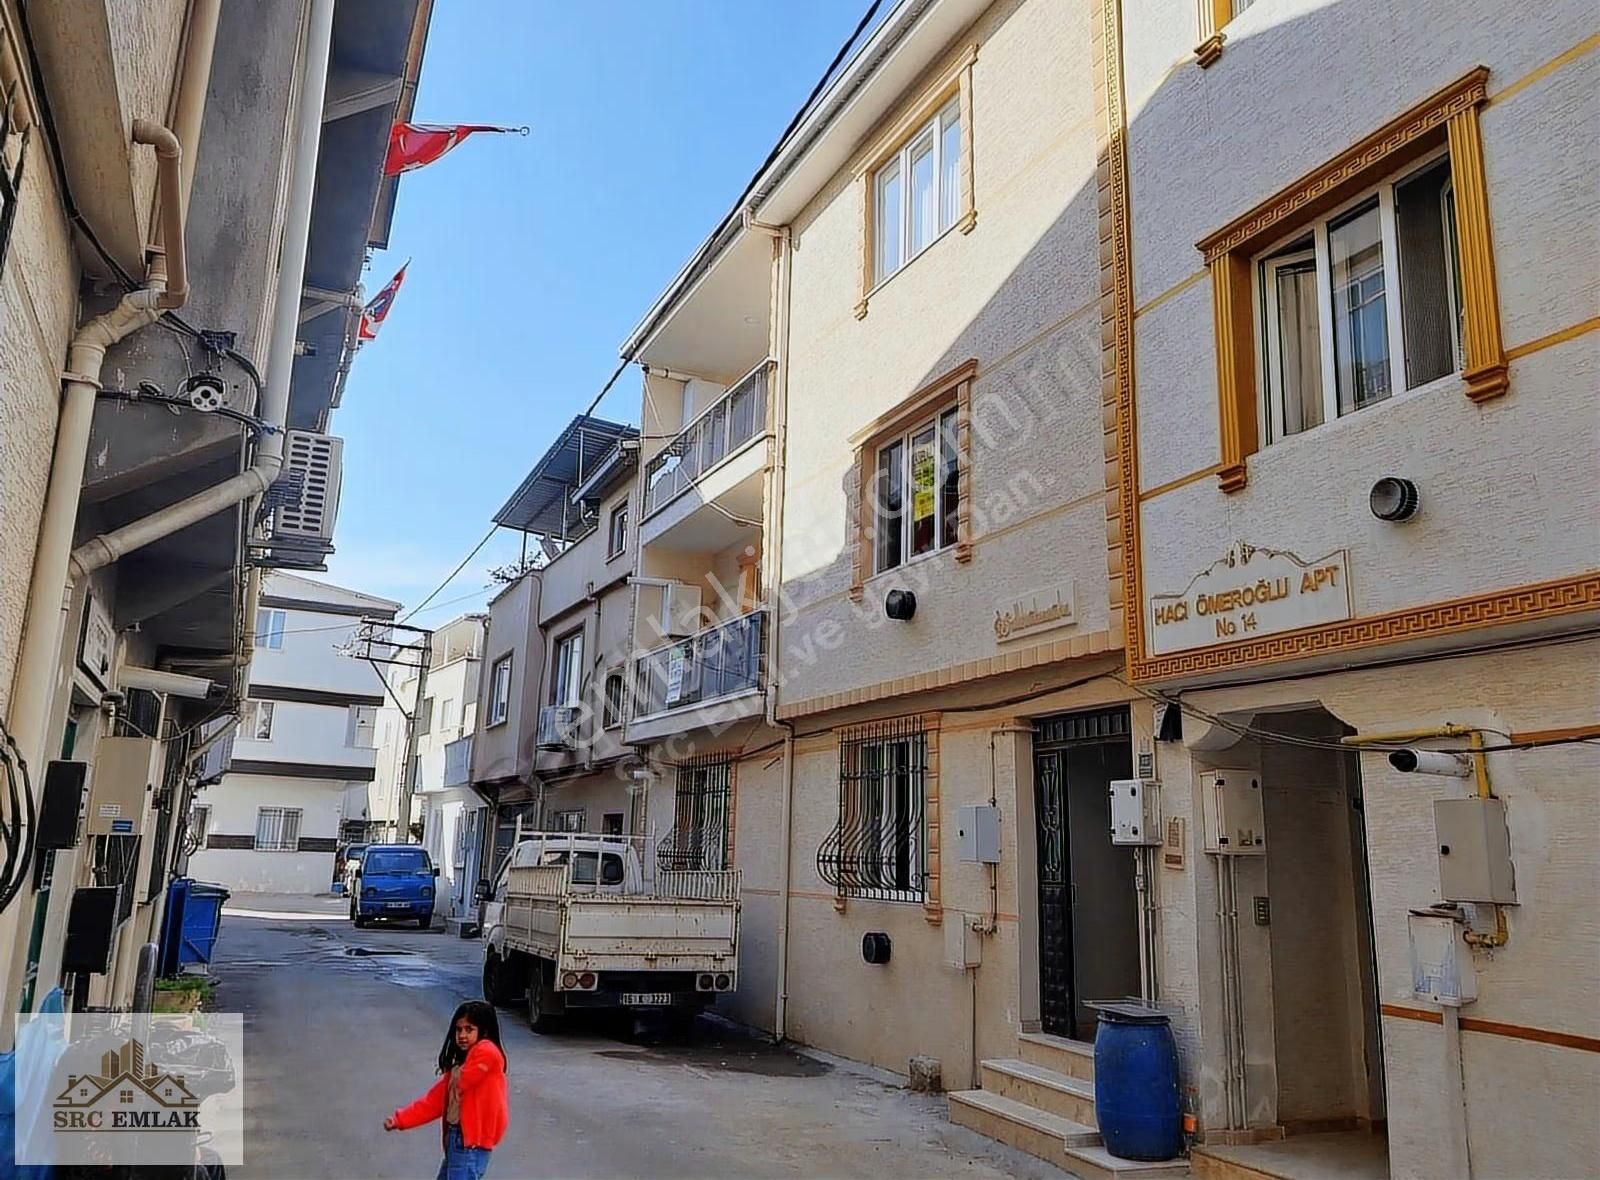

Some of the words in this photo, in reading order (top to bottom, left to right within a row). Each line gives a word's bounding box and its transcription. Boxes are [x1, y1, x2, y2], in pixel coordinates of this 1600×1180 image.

[1197, 577, 1289, 616] ÖMEROĞLU
[1301, 565, 1339, 594] APT
[1216, 617, 1236, 638] No
[1241, 611, 1258, 633] 14
